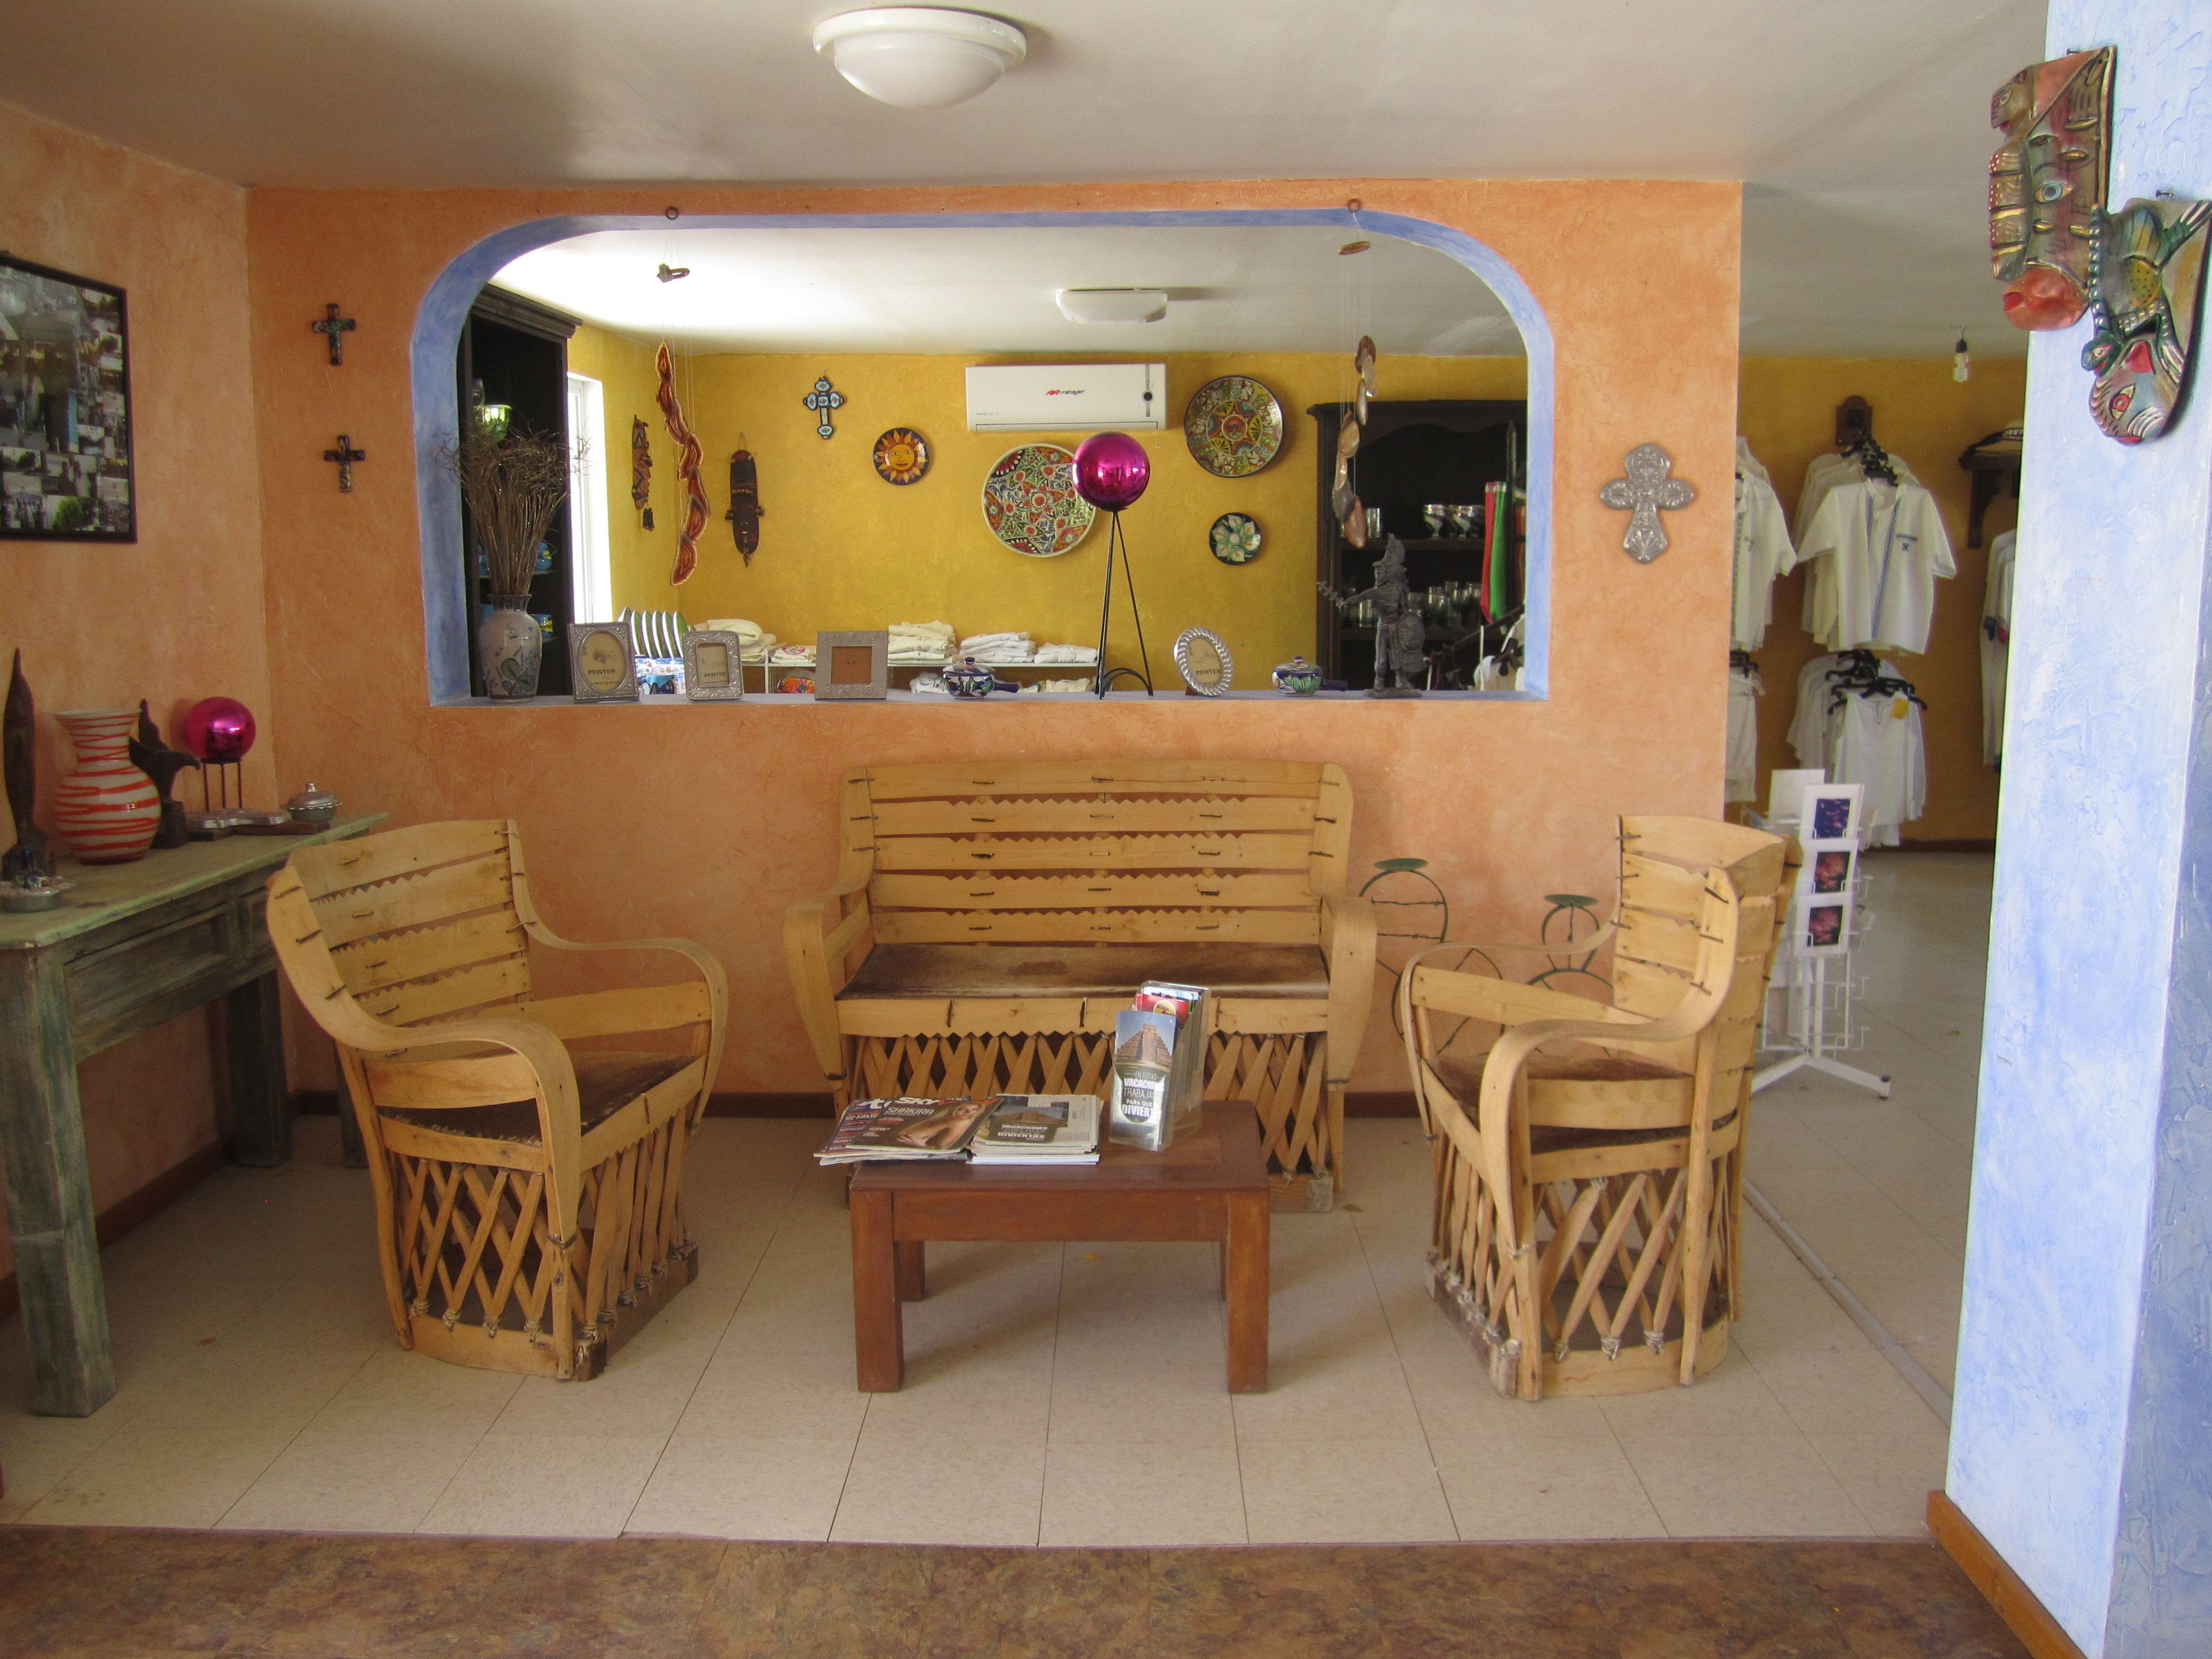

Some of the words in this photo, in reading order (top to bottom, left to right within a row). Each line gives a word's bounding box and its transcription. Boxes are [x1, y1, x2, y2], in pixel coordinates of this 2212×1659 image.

[1142, 1072, 1157, 1080] ESTAS
[1124, 1078, 1164, 1092] VACACION
[1124, 1087, 1158, 1100] TRABAJA
[886, 1107, 934, 1115] SHAKIRA
[1122, 1104, 1154, 1117] DIVIERT
